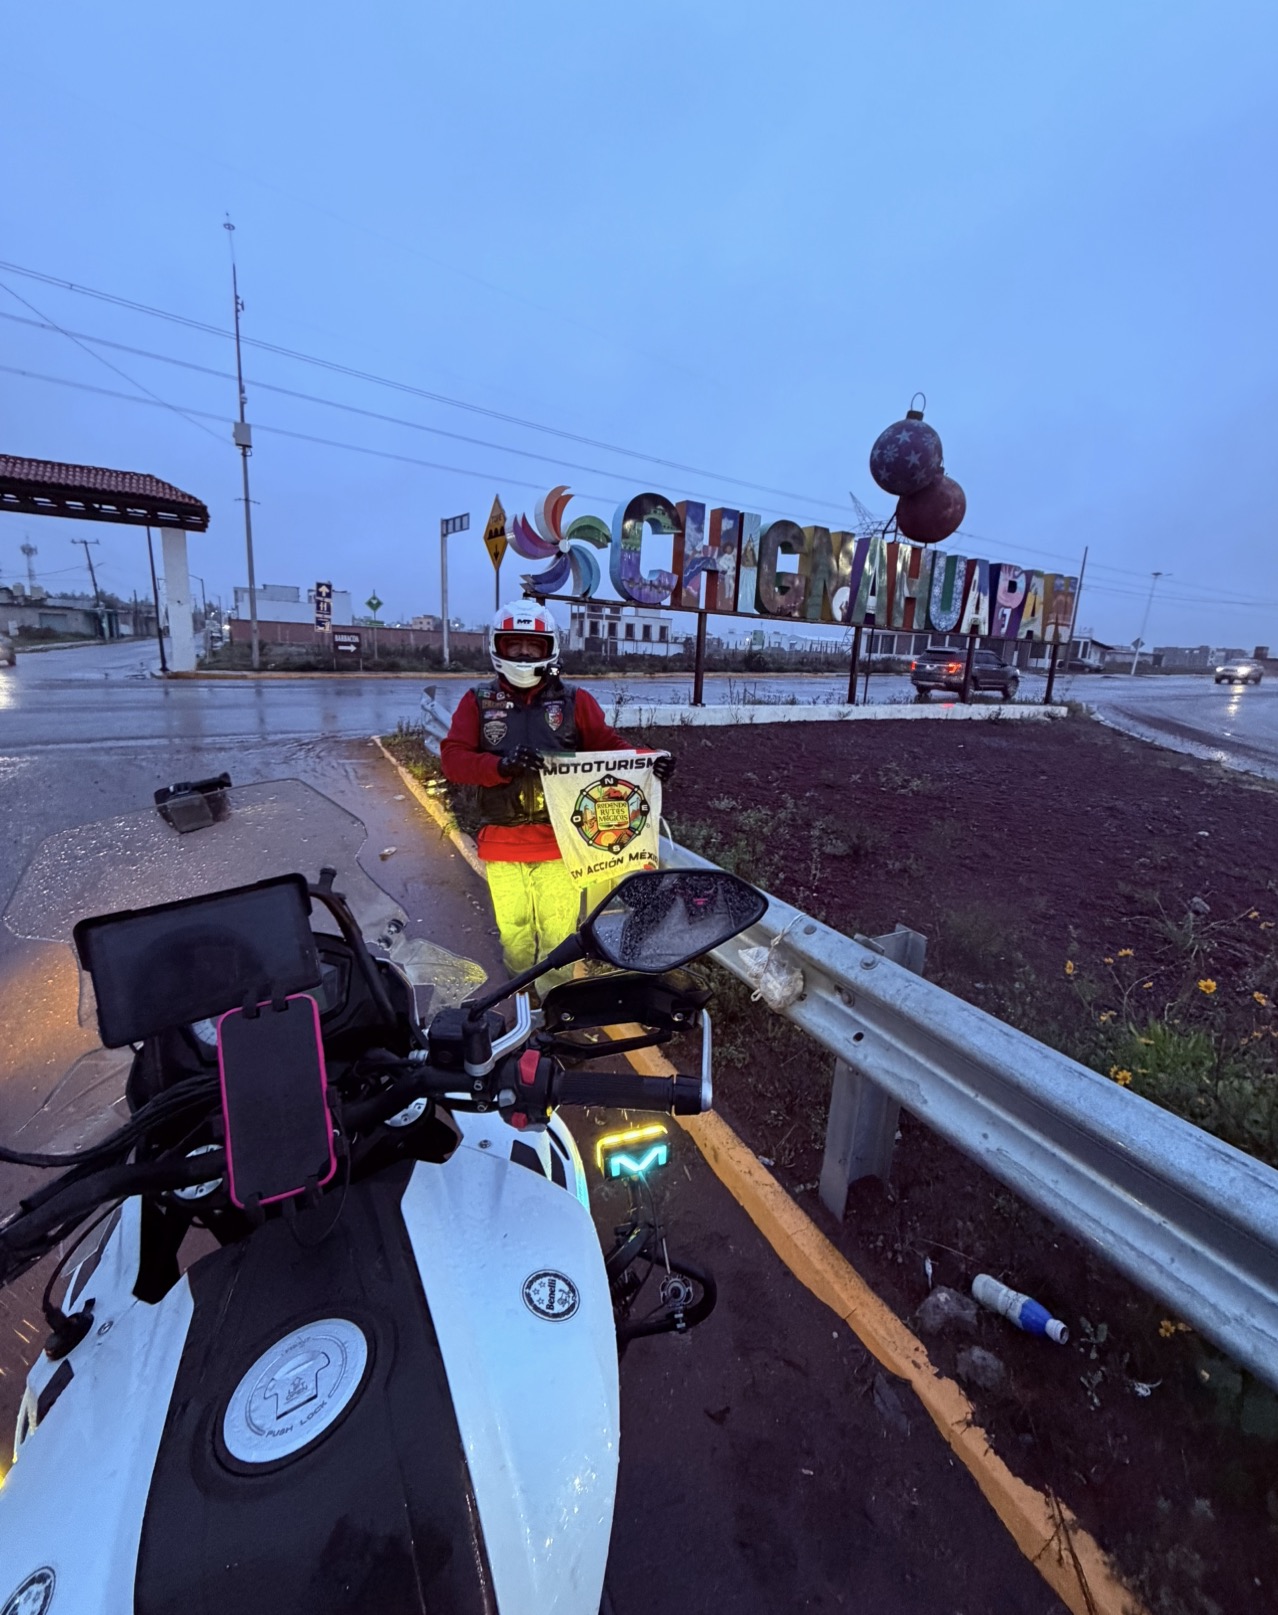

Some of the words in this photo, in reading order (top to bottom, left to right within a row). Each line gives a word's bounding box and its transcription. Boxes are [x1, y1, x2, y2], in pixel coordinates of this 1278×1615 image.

[609, 492, 1078, 644] CHIGNAHUAPAN
[542, 757, 656, 776] MOTOTURISM
[604, 777, 614, 785] N
[572, 815, 581, 823] O
[612, 844, 621, 852] S
[587, 855, 624, 875] ACCIÓN
[545, 1278, 557, 1311] Benelli
[265, 1425, 294, 1438] PUSH
[299, 1400, 328, 1426] LOCK
